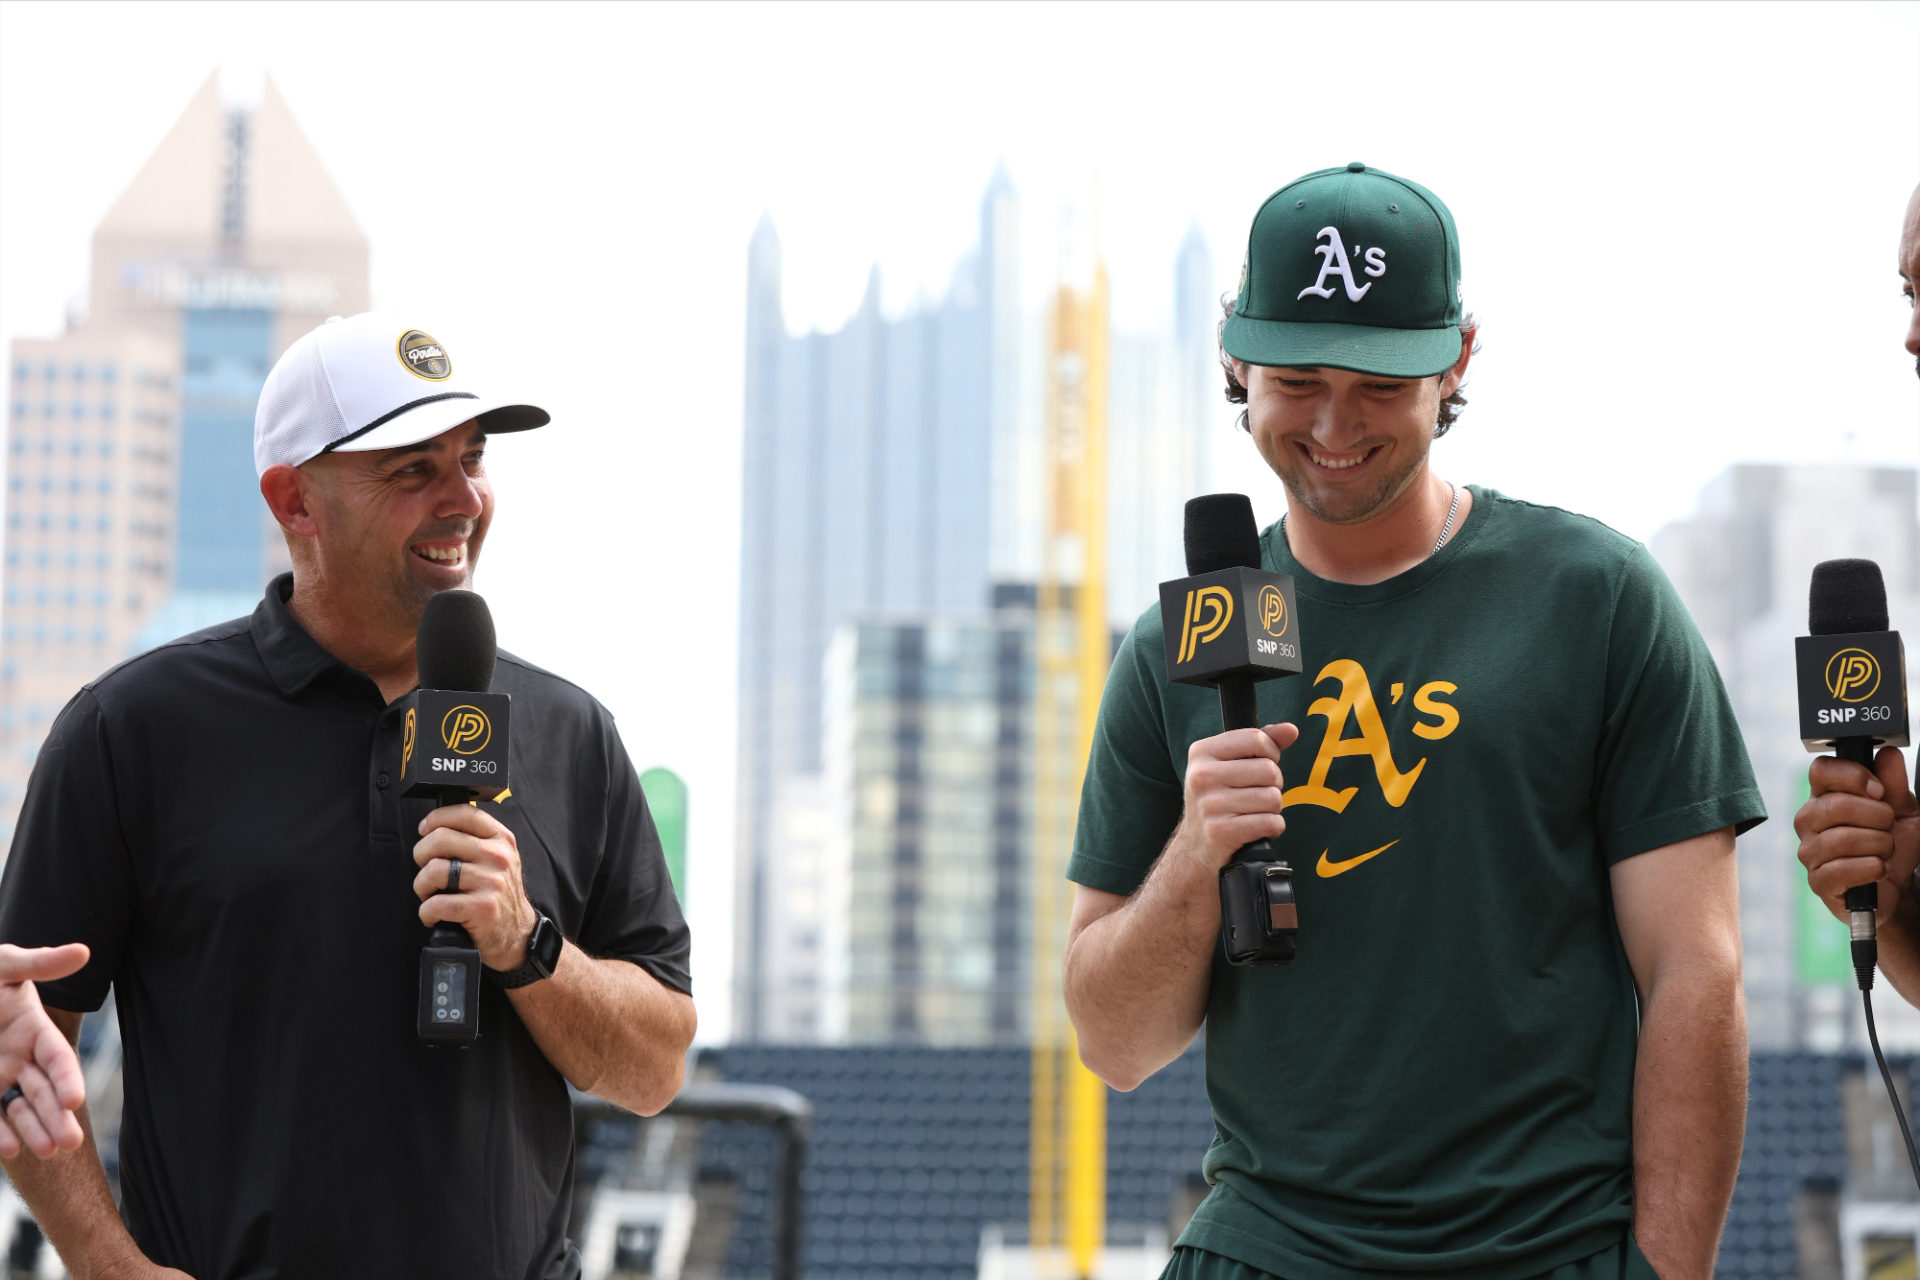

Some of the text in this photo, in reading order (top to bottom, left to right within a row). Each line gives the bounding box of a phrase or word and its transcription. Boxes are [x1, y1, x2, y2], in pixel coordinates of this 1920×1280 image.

[1297, 226, 1386, 303] A's
[1257, 639, 1296, 658] SNP 360
[1817, 705, 1891, 724] SNP 360
[1281, 658, 1460, 814] A's
[431, 757, 497, 774] SNP 360
